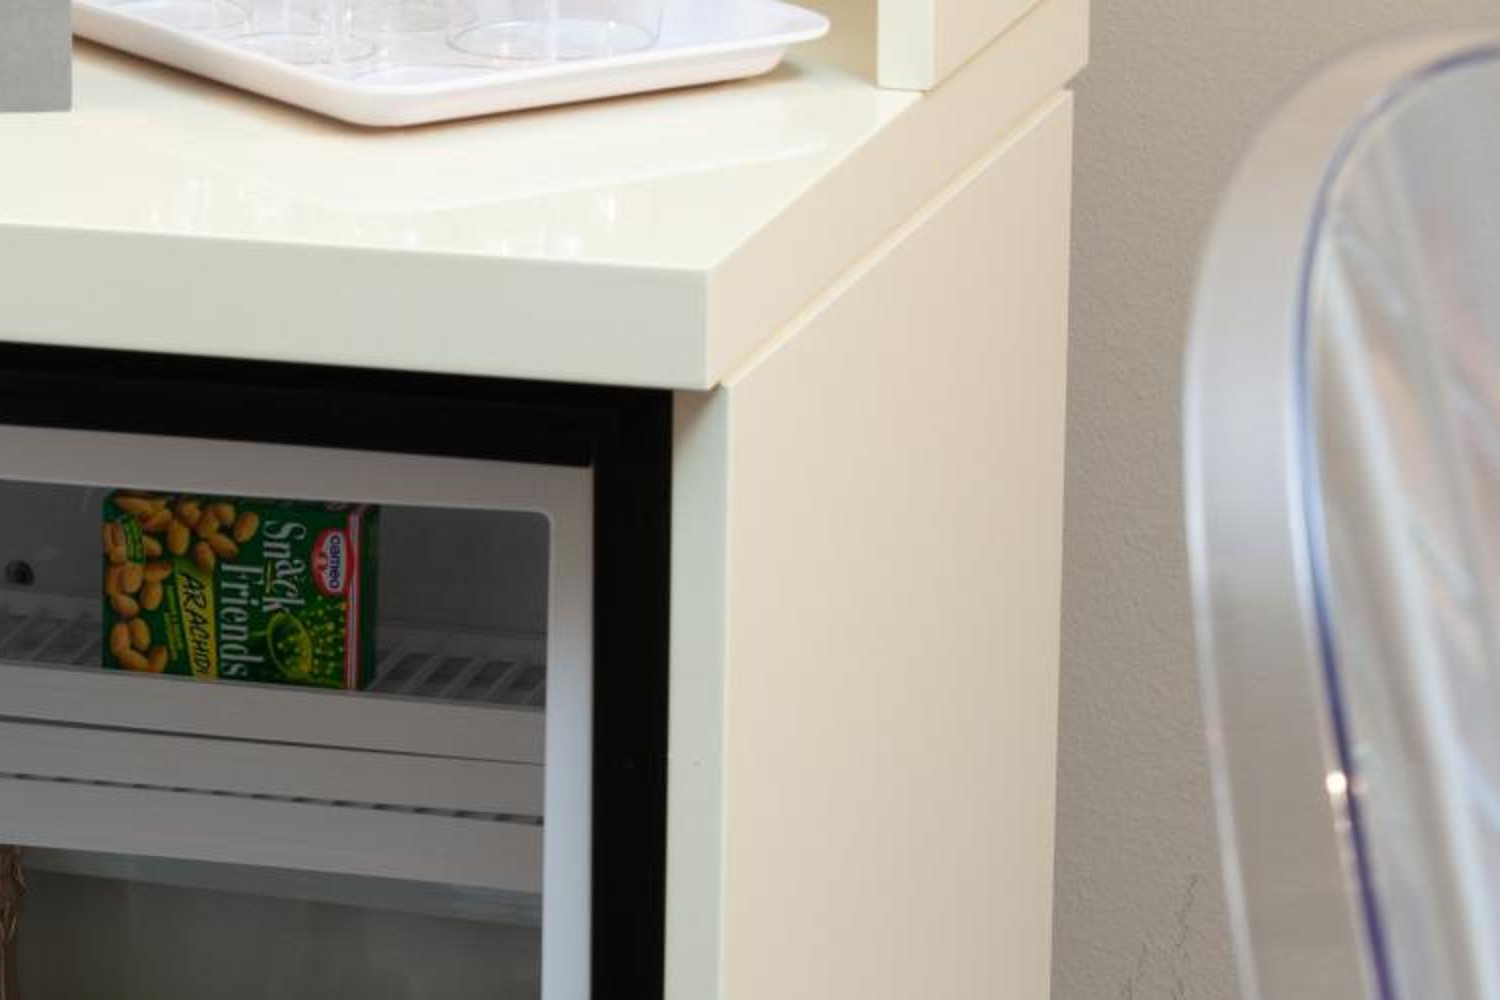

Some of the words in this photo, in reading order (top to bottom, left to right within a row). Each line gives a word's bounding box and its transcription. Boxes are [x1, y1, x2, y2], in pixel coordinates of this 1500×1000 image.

[262, 520, 308, 613] Snack
[328, 533, 342, 590] cameo
[220, 563, 265, 677] Friends
